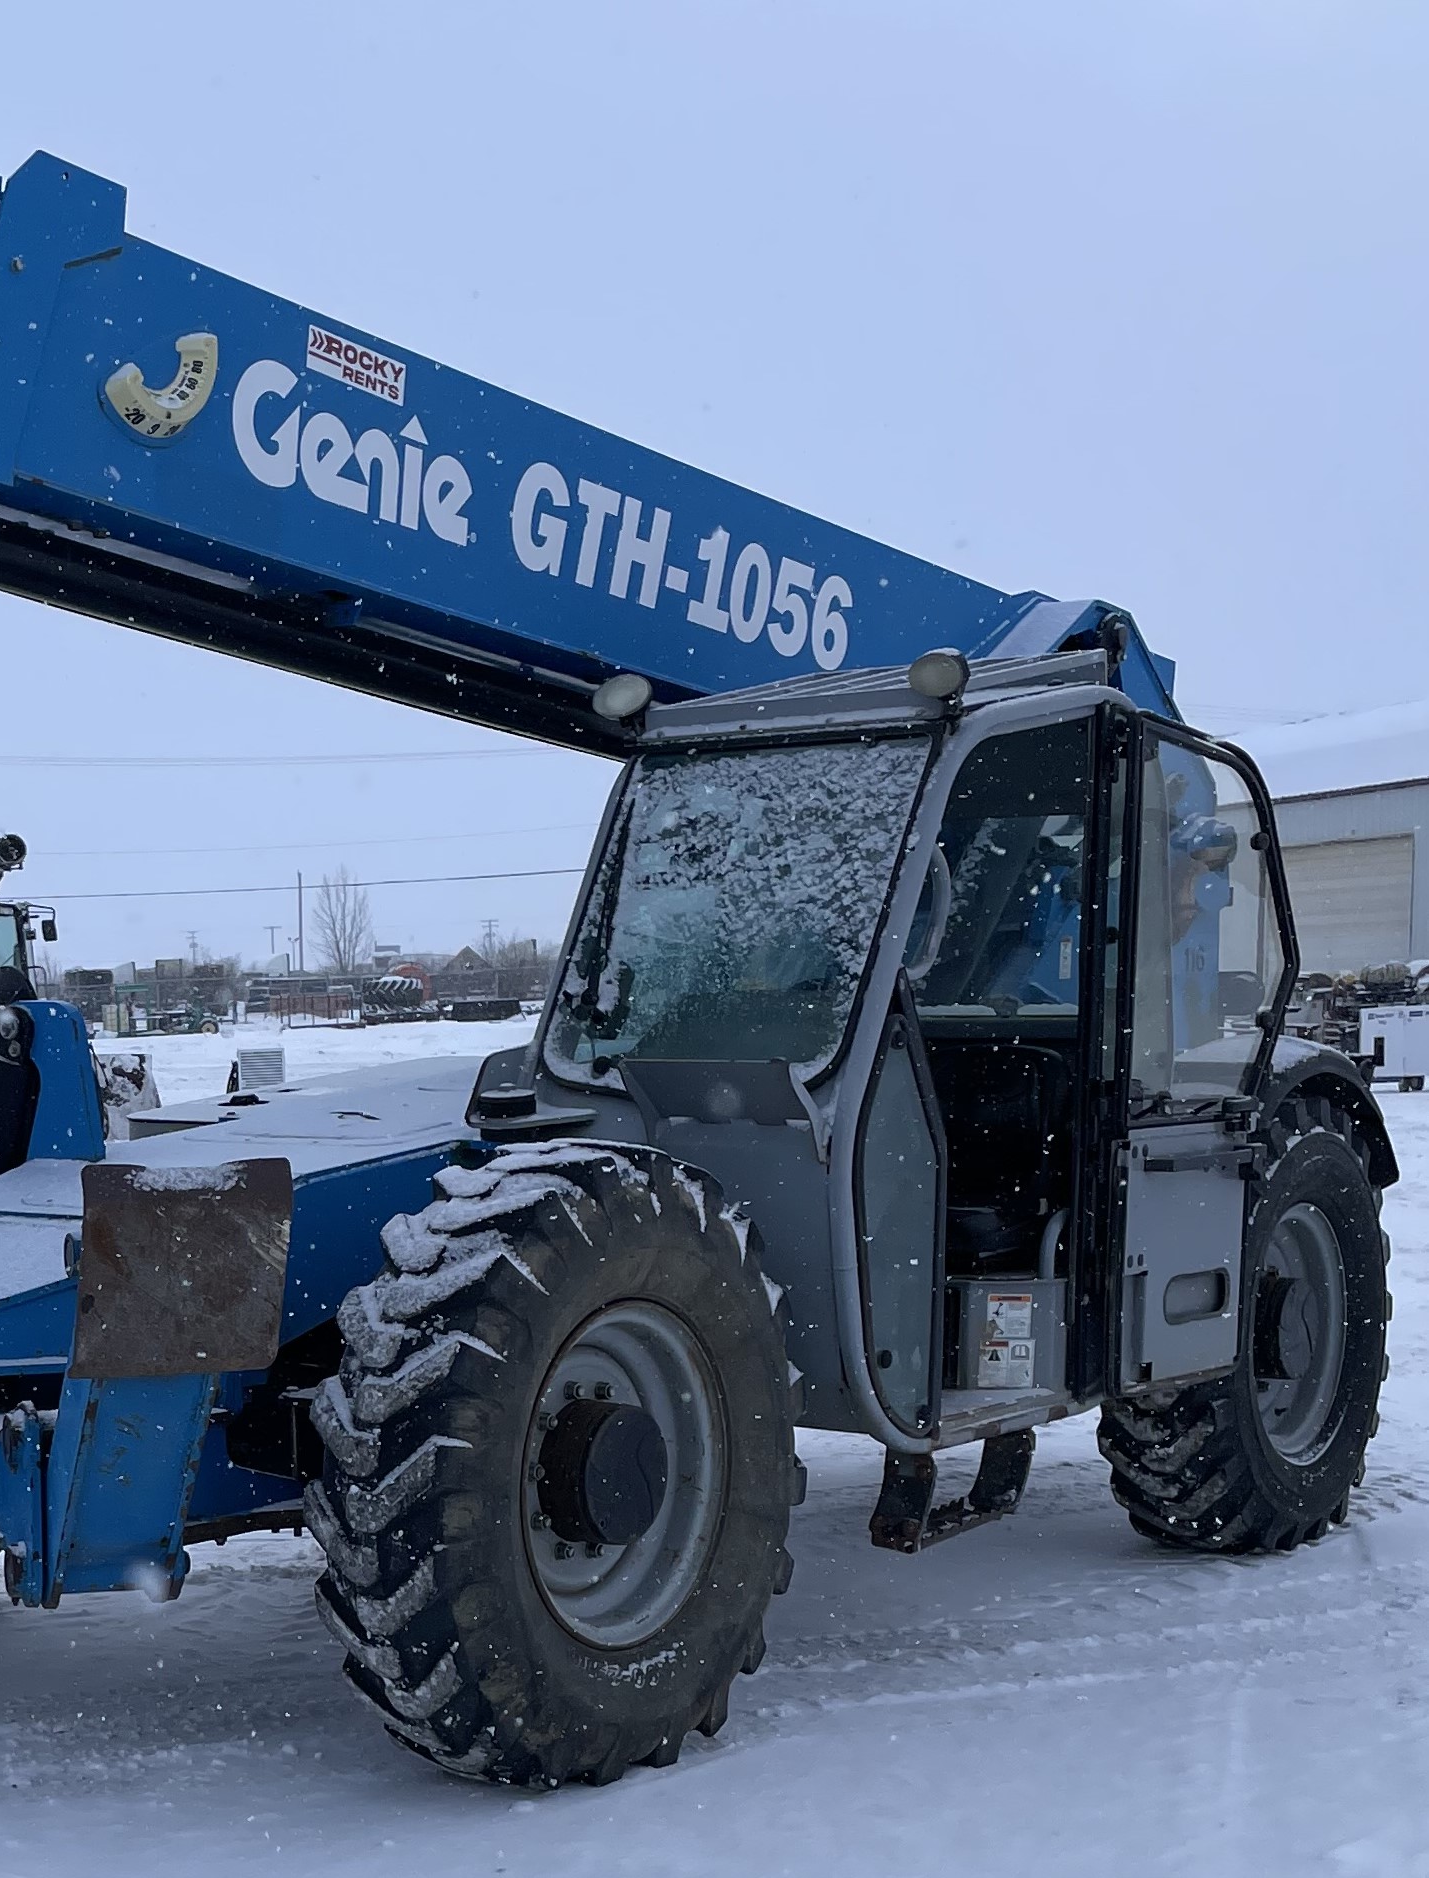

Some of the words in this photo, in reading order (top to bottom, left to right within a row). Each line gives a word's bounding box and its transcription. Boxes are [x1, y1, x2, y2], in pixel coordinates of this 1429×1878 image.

[323, 334, 404, 383] ROCKY
[342, 370, 400, 400] RENTS
[124, 407, 146, 425] -20
[191, 360, 204, 375] 80
[232, 359, 473, 547] Genie
[511, 461, 854, 671] GTH-1056
